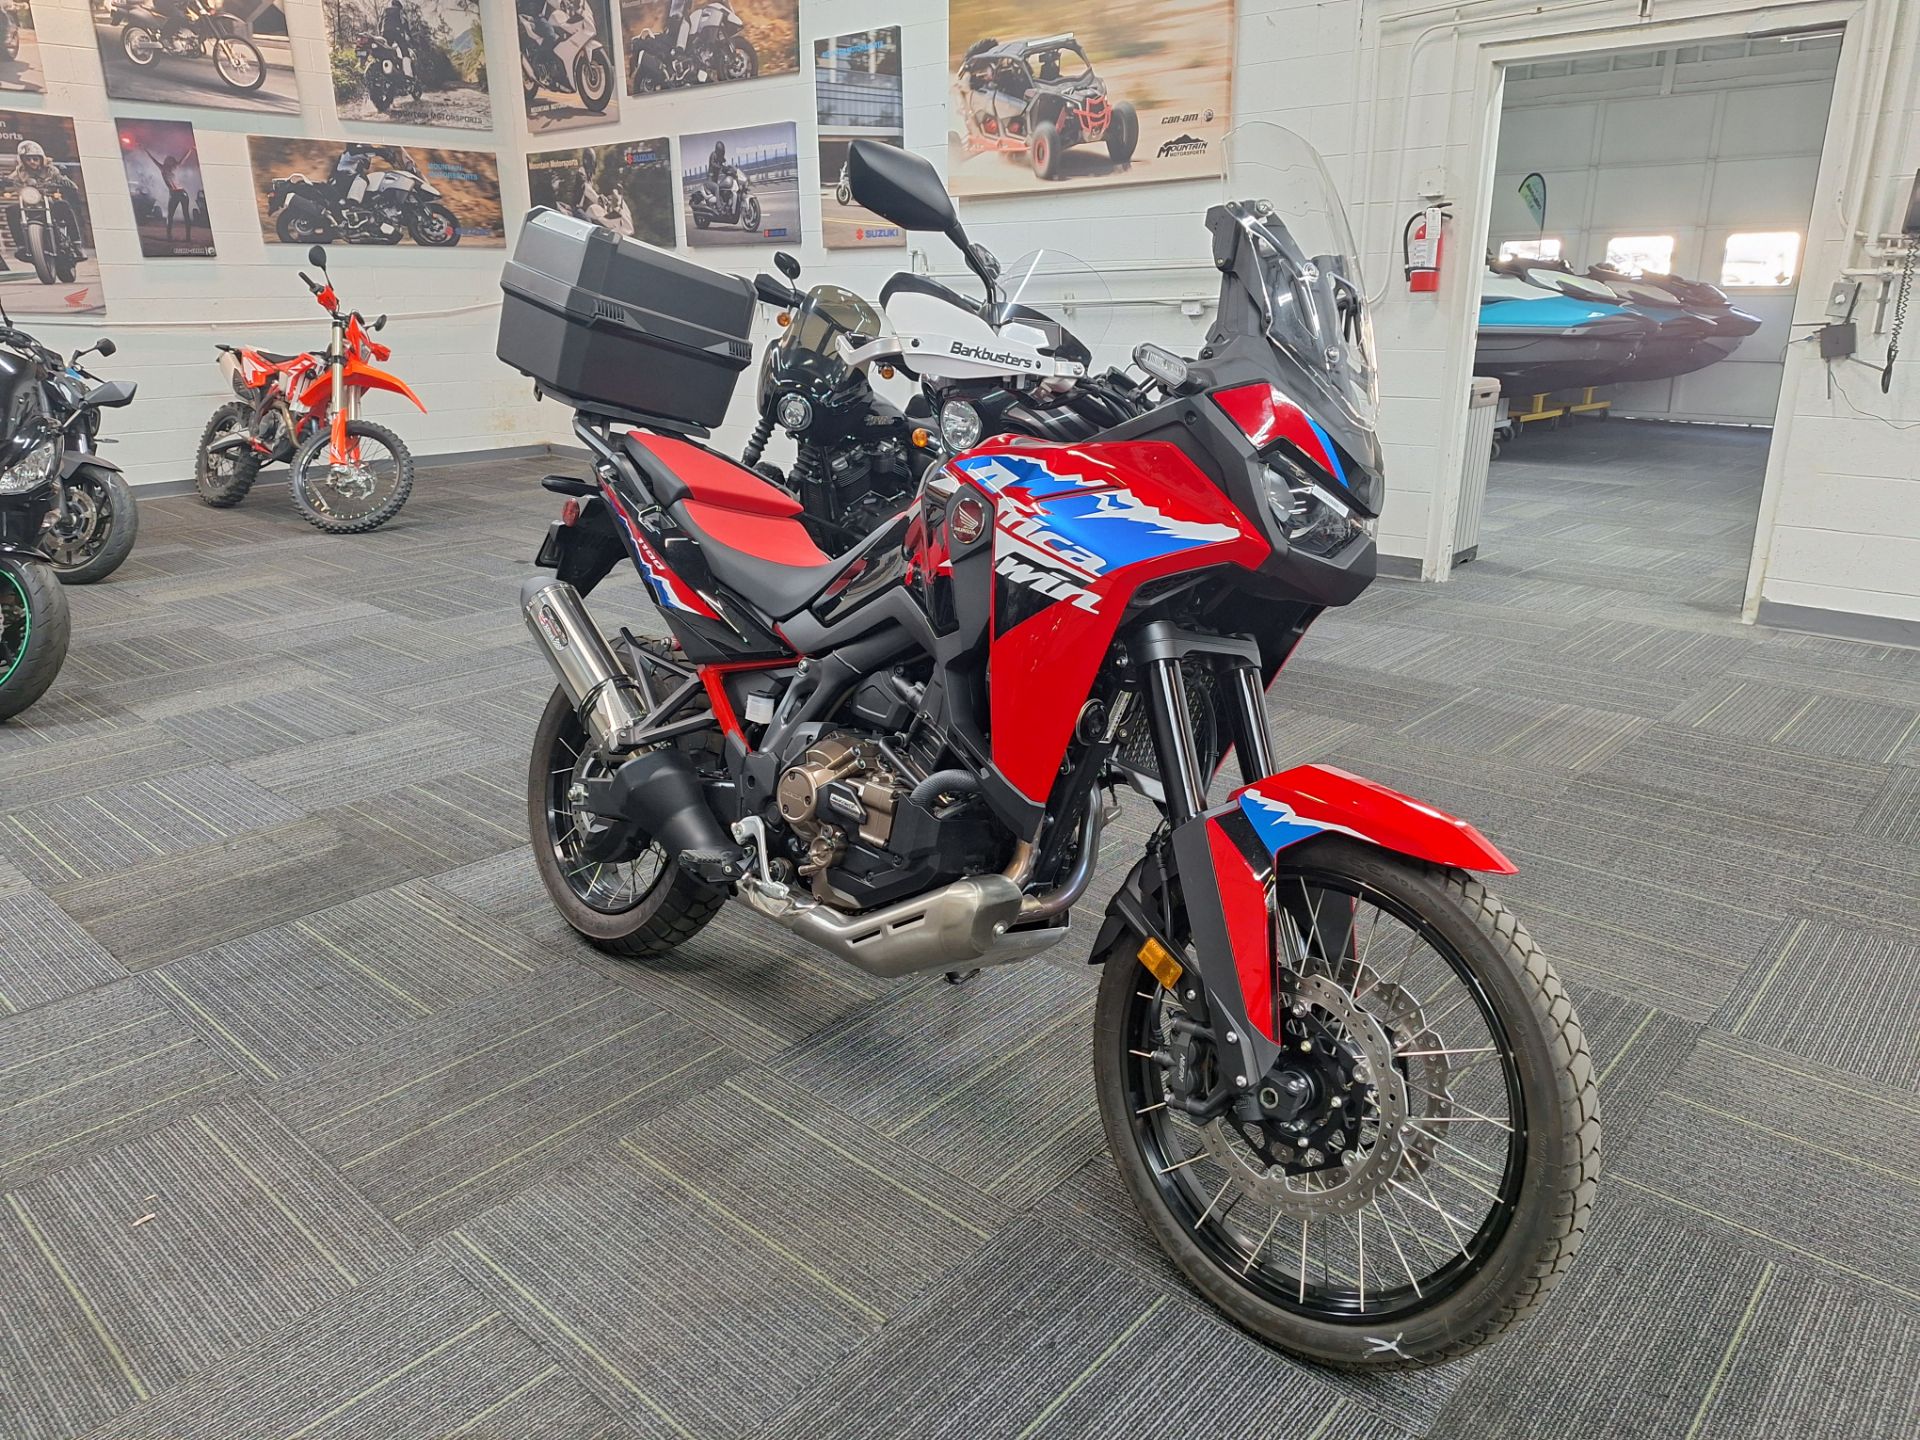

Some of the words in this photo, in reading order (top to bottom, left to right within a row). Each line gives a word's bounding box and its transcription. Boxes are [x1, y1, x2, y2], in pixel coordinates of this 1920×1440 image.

[1157, 141, 1208, 158] MOUNTAIN
[1169, 149, 1206, 157] MOTORSPORTS
[864, 229, 899, 239] SUZUKI
[949, 341, 1032, 369] Barkbusters
[637, 537, 666, 570] 1100
